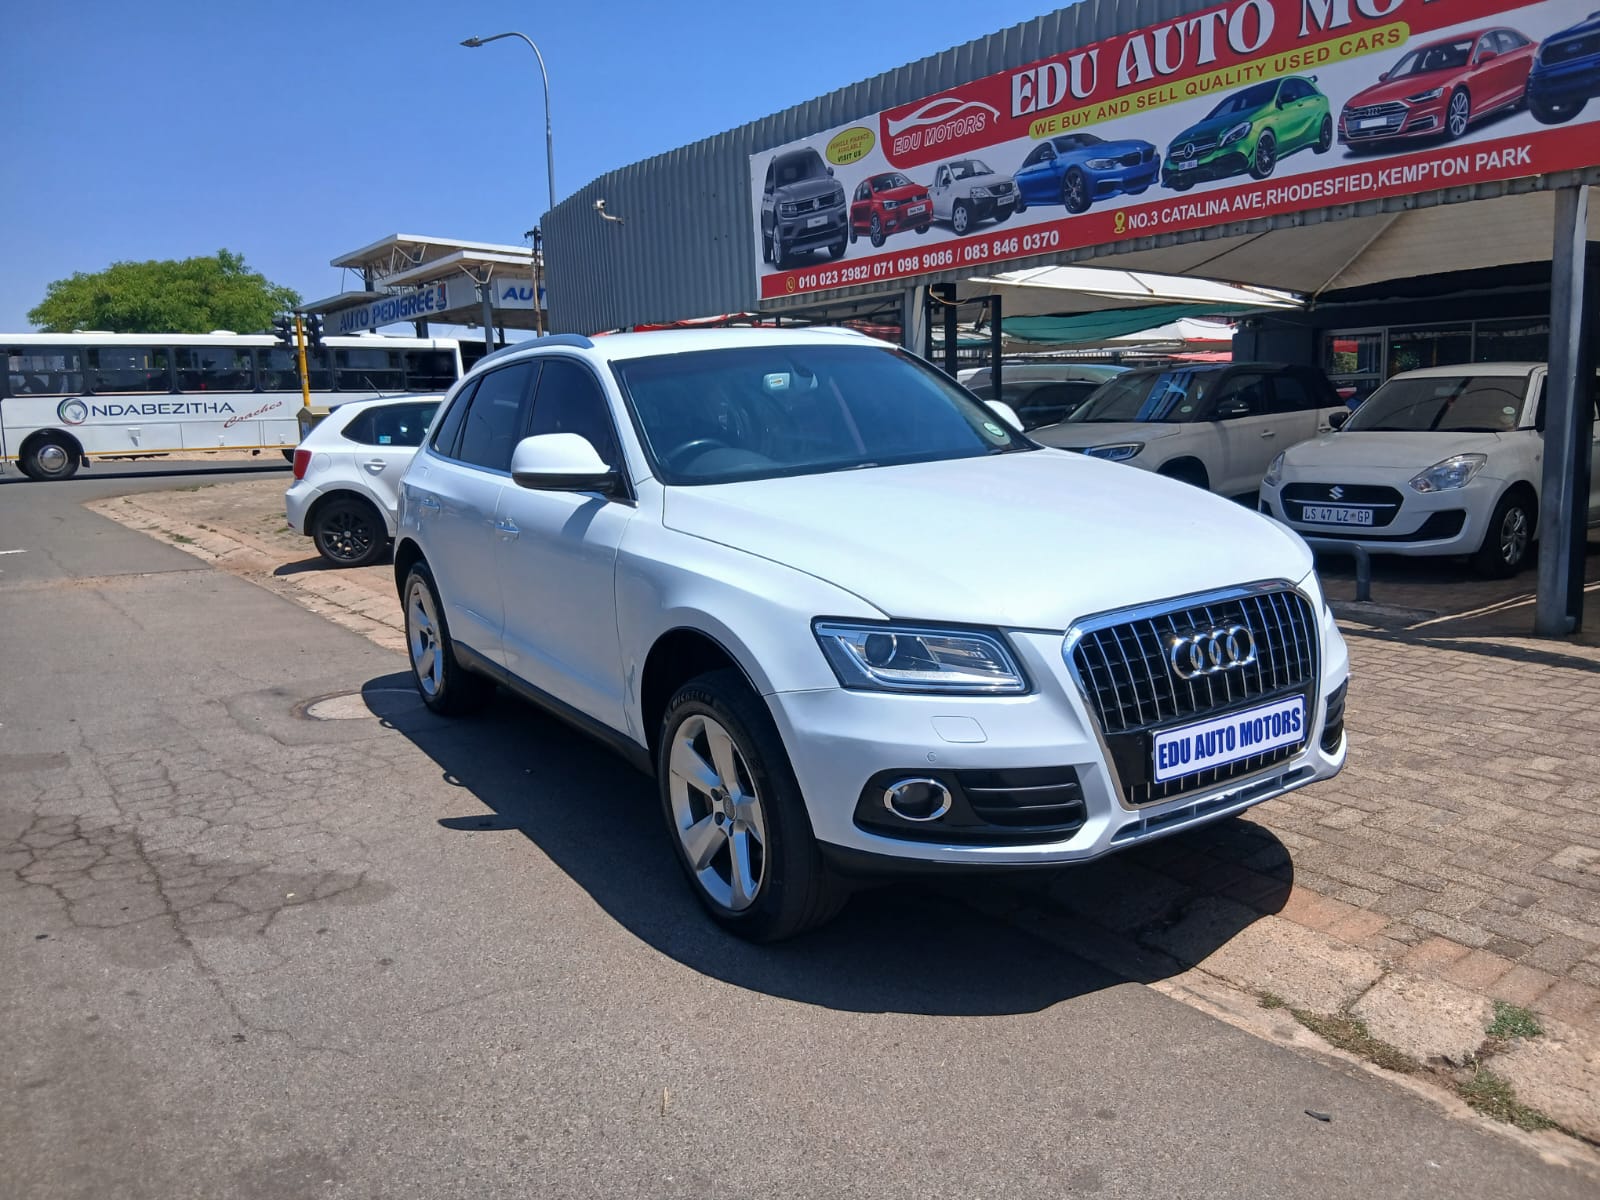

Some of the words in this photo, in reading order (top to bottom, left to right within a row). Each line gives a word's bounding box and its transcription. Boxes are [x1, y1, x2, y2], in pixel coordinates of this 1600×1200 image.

[1011, 48, 1100, 118] EDU
[1116, 0, 1275, 88] AUTO
[1035, 120, 1056, 135] WE
[1062, 111, 1091, 129] BUY
[1097, 100, 1130, 119] AND
[1136, 88, 1178, 108] SELL
[1185, 63, 1267, 96] QUALITY
[1274, 47, 1330, 73] USED
[1339, 28, 1401, 56] CARS
[893, 132, 922, 156] EDU
[924, 112, 986, 147] MOTORS
[1128, 212, 1158, 230] NO.3
[1161, 198, 1230, 224] CATALINA
[1475, 145, 1532, 172] PARK
[799, 274, 817, 289] 010
[820, 271, 839, 286] 023
[873, 261, 894, 277] 071
[897, 256, 919, 273] 098
[923, 250, 953, 268] 9086
[964, 243, 989, 261] 083
[993, 237, 1018, 255] 846
[1023, 230, 1060, 250] 0370
[339, 308, 369, 332] AUTO
[371, 289, 434, 325] PEDIGREE
[92, 401, 235, 417] NDABEZITHA
[223, 400, 283, 429] Coaches
[1304, 507, 1316, 520] LS
[1320, 508, 1332, 521] 47
[1336, 510, 1349, 522] LZ
[1357, 511, 1370, 523] GP
[1158, 737, 1191, 770] EDU
[1194, 725, 1236, 760] AUTO
[1239, 707, 1301, 748] MOTORS
